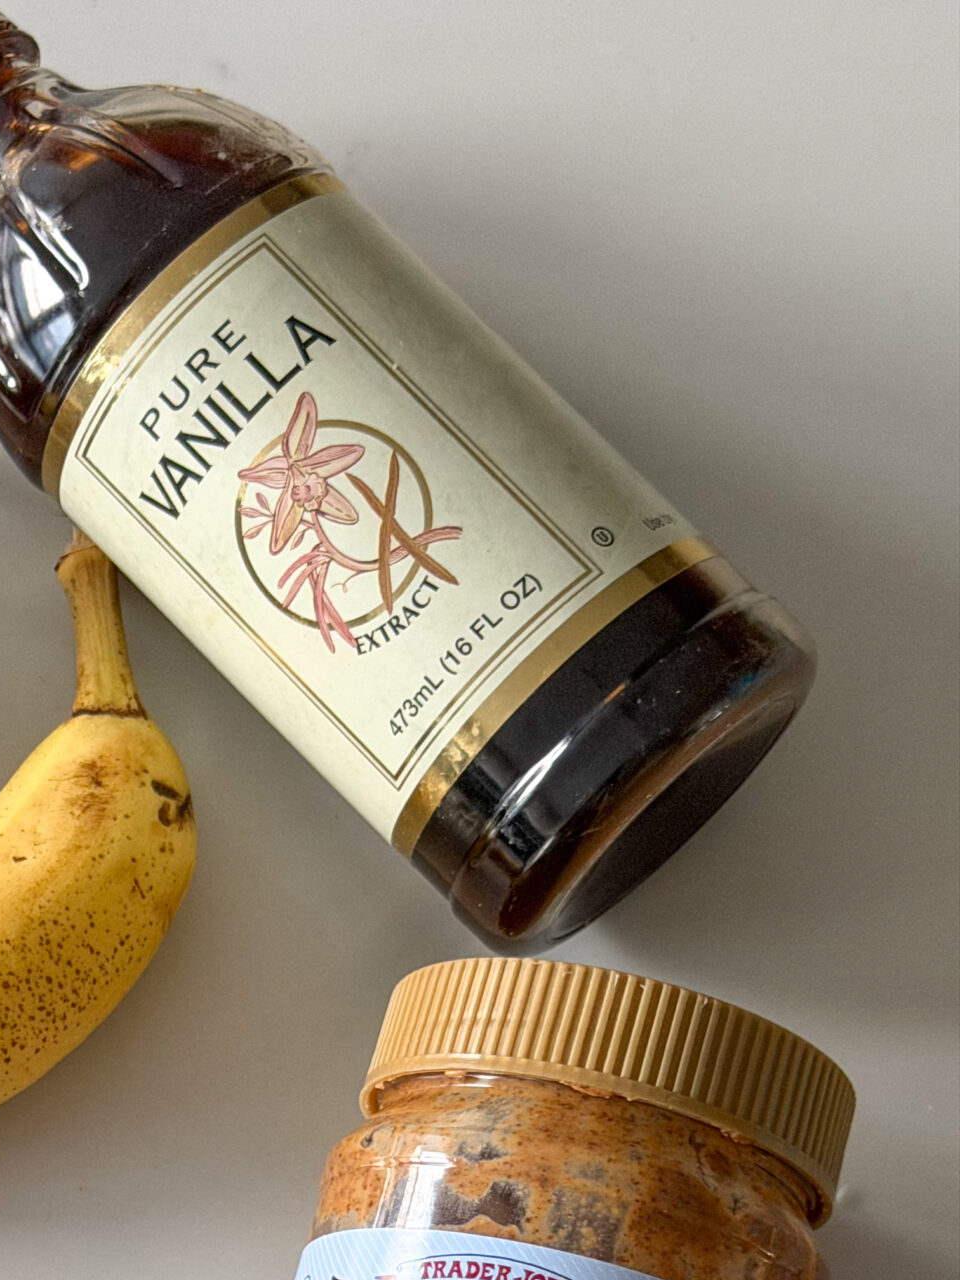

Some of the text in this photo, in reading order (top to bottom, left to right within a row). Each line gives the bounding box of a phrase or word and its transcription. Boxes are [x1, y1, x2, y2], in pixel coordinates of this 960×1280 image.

[139, 319, 247, 442] PURE
[139, 315, 337, 520] VANILLA
[355, 575, 440, 656] EXTRACT
[389, 573, 544, 736] 473mL (16 FL OZ)
